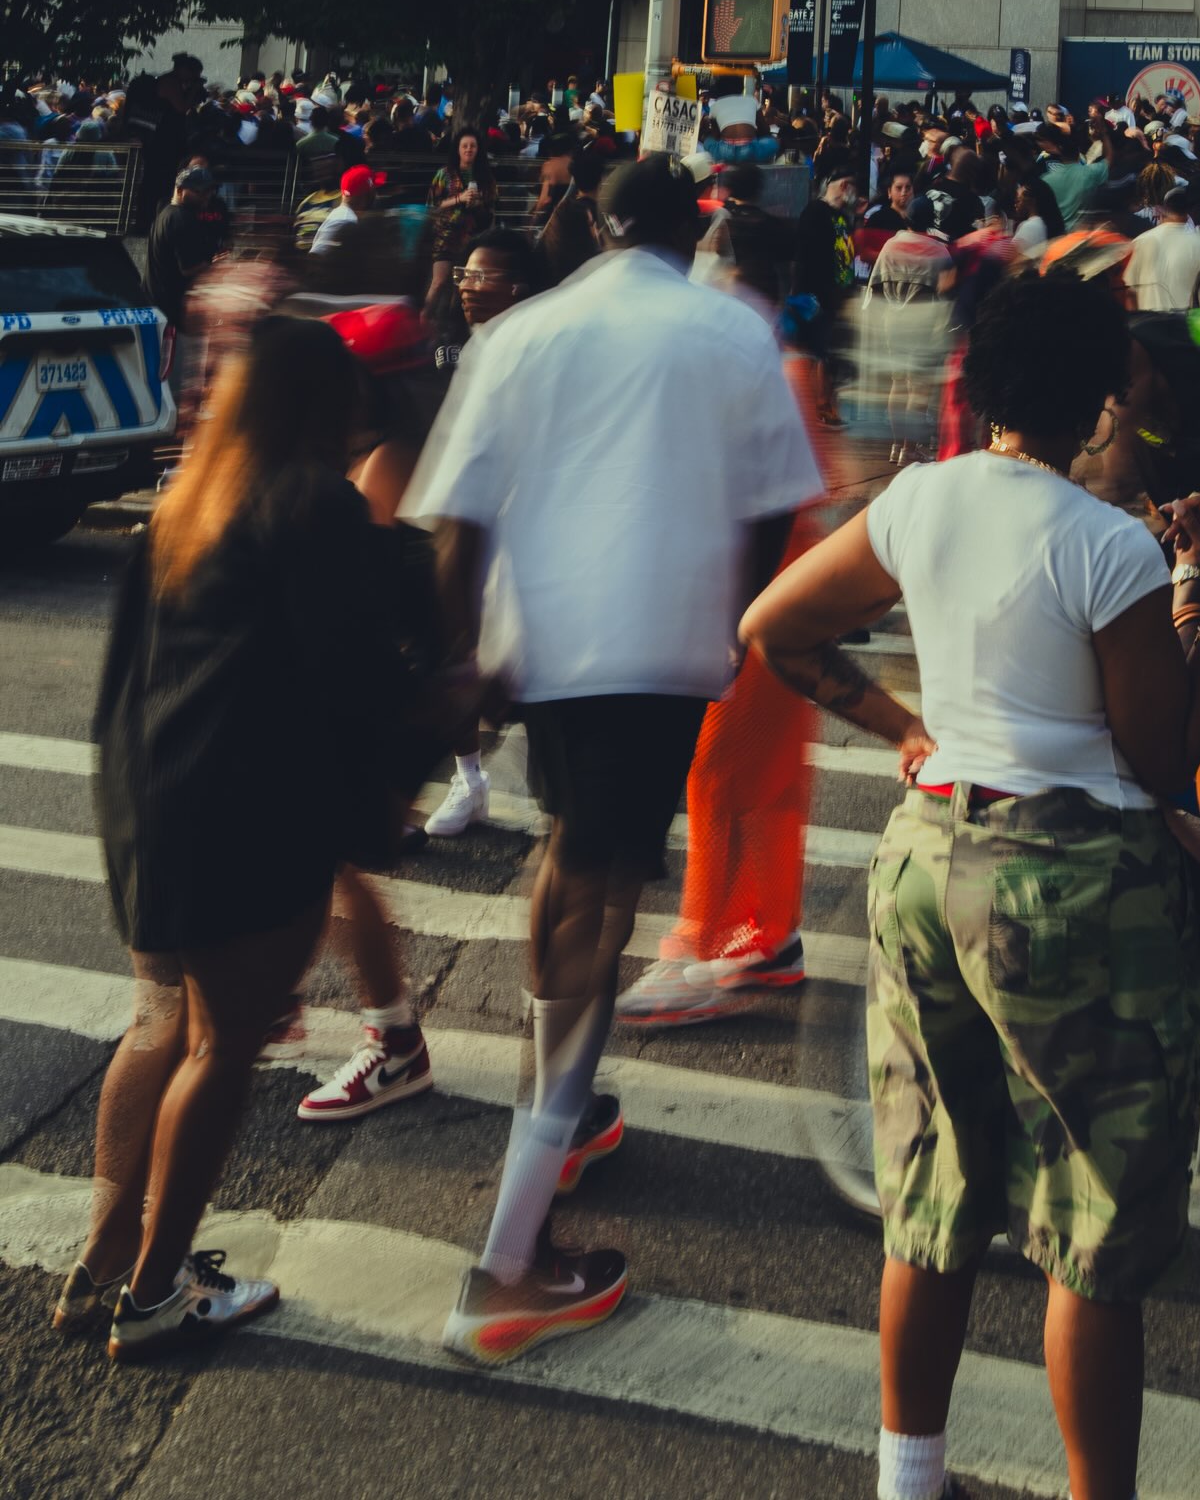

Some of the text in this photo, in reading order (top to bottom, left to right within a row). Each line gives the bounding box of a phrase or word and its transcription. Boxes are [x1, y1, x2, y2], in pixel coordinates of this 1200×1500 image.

[788, 9, 814, 20] GATE 2
[1128, 45, 1163, 61] TEAM
[654, 96, 698, 121] CASAC
[40, 361, 87, 385] 371423
